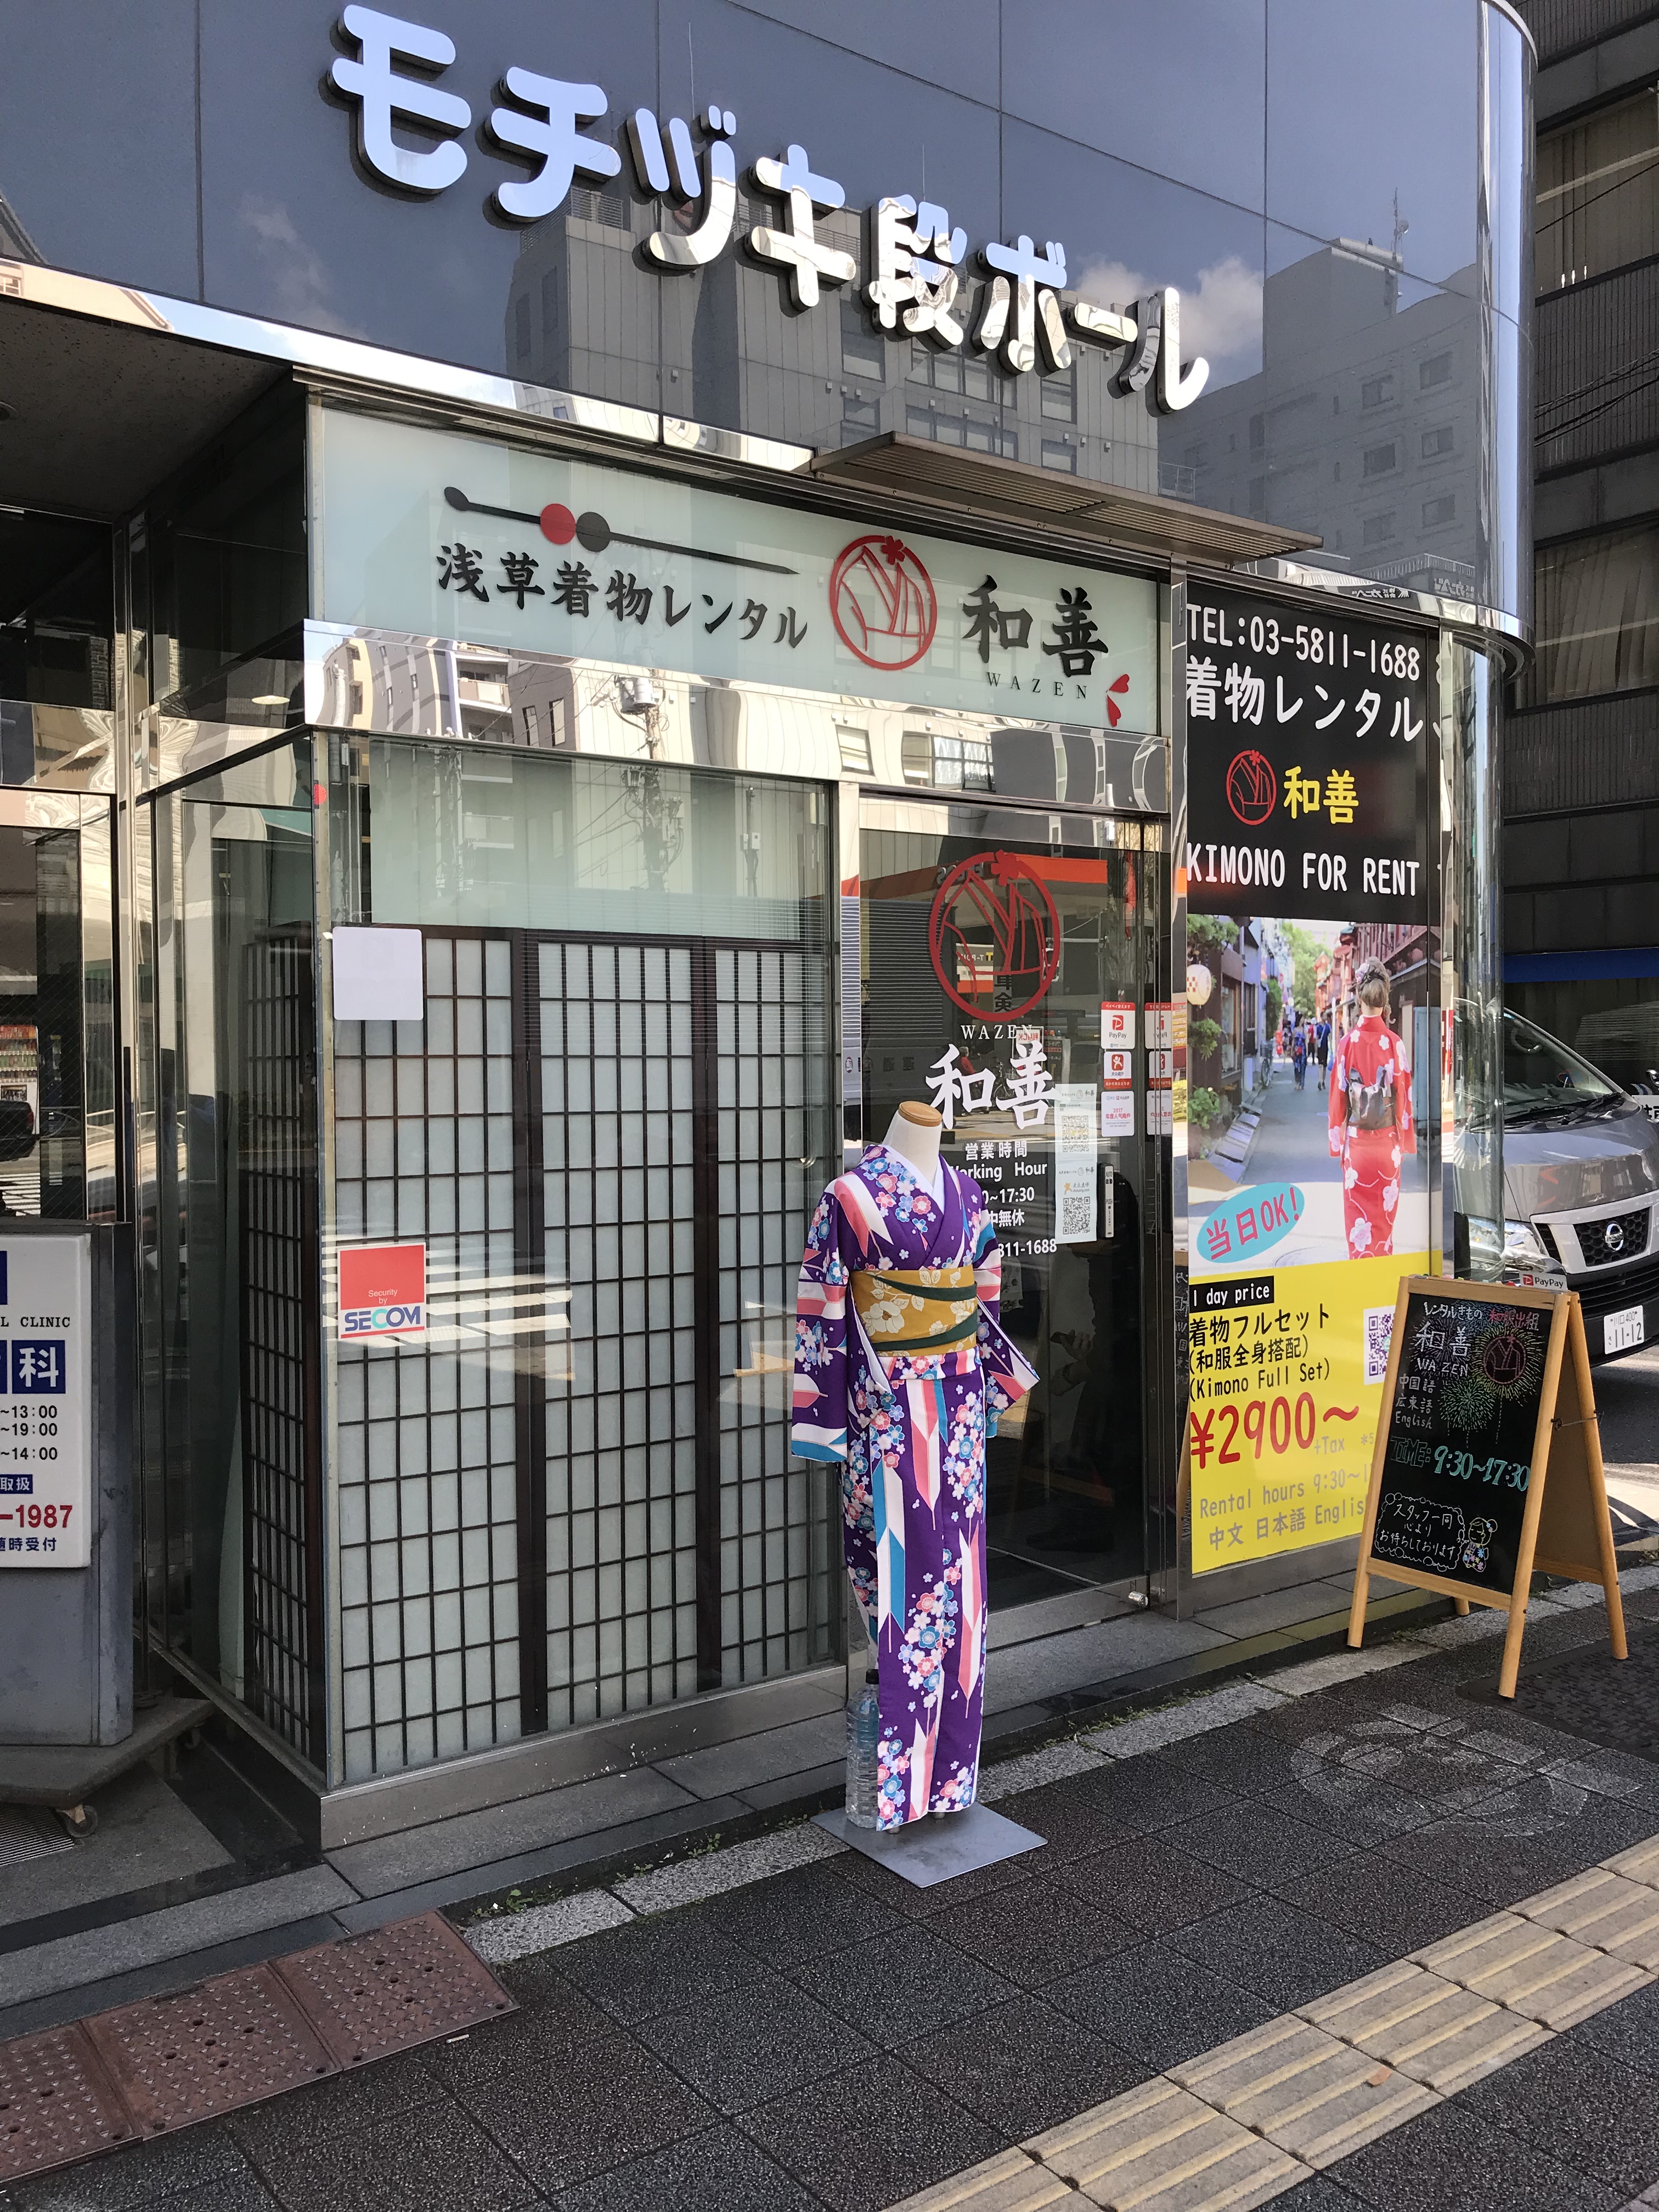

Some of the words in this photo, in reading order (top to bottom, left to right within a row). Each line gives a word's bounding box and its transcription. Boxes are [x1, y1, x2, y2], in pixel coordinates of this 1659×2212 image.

[331, 3, 1210, 411] モチヅキ段ボール
[436, 541, 808, 649] 浅草着物レンタル
[962, 574, 1109, 678] 和善
[1187, 603, 1420, 681] TEL:03-5811-1688
[986, 671, 1087, 700] WAZEN
[1187, 654, 1424, 742] 着物レンタル
[1283, 766, 1359, 824] 和善
[1187, 842, 1285, 888] KIMONO
[1302, 852, 1347, 891] FOR
[1363, 857, 1420, 896] RENT
[960, 1024, 1032, 1040] WAZEN
[926, 1040, 1064, 1130] 和善
[965, 1140, 1028, 1161] 営業時間
[950, 1163, 1002, 1182] orking
[1014, 1161, 1047, 1176] Hour
[1206, 1186, 1300, 1260] 当日OK!
[368, 1288, 398, 1297] Security
[1206, 1287, 1228, 1306] day
[1235, 1283, 1270, 1304] price
[1534, 1277, 1564, 1288] PayPay
[379, 1297, 388, 1305] by
[1423, 1301, 1482, 1321] レンタルきもの
[20, 1316, 71, 1328] CLINIC
[344, 1306, 421, 1332] SECOM
[1189, 1303, 1329, 1348] 着物フルセット
[1414, 1321, 1471, 1357] 和善
[1615, 1322, 1643, 1348] 11-12
[18, 1346, 59, 1387] 科
[1189, 1377, 1249, 1402] (Kimono
[1258, 1365, 1289, 1390] Full
[1299, 1357, 1330, 1383] Set)
[1398, 1373, 1437, 1393] 中国語
[1395, 1393, 1434, 1414] 広東語
[1395, 1410, 1432, 1430] English
[1313, 1435, 1345, 1455] +Tax
[1390, 1435, 1431, 1468] TIME:
[1434, 1445, 1531, 1492] 9:30~17:30
[1200, 1488, 1251, 1519] Rental
[1262, 1482, 1305, 1505] hours
[1209, 1522, 1244, 1551] 中文
[1256, 1506, 1306, 1540] 日本語
[1404, 1523, 1431, 1537] 心より
[1379, 1529, 1456, 1560] お待ちしております
